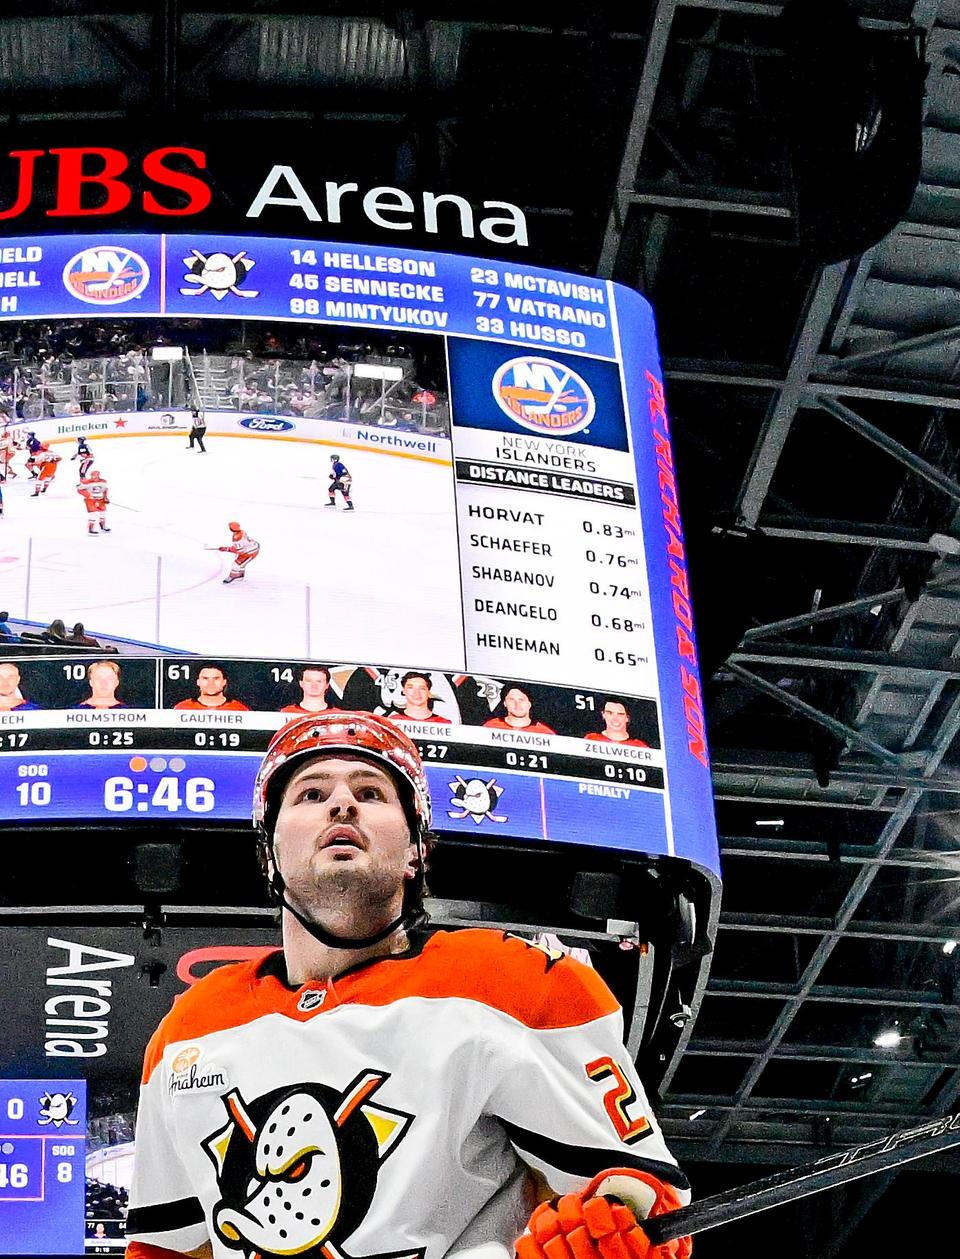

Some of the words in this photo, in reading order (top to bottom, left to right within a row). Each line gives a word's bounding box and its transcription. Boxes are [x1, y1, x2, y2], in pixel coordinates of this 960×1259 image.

[246, 165, 528, 247] Arena
[82, 251, 134, 274] NY
[289, 251, 317, 268] 14
[323, 253, 437, 278] HELLESON
[288, 275, 319, 292] 45
[324, 276, 445, 304] SENNECKE
[470, 270, 499, 286] 23
[504, 273, 605, 305] MCTAVISH
[288, 299, 319, 317] 98
[324, 302, 449, 329] MINTYUKOV
[474, 292, 501, 310] 77
[506, 297, 607, 329] VATRANO
[476, 317, 505, 335] 33
[510, 321, 587, 349] HUSSO
[512, 361, 574, 391] NY
[58, 421, 108, 435] Heineken
[248, 417, 285, 431] Ford
[357, 430, 436, 453] Northwell
[503, 435, 540, 451] NEW
[544, 443, 587, 459] YORK
[496, 447, 597, 473] ISLANDERS
[468, 464, 549, 490] DISTANCE
[551, 477, 626, 502] LEADERS
[467, 504, 546, 526] HORVAT
[469, 533, 553, 559] SCHAEFER
[471, 564, 555, 589] SHABANOV
[474, 598, 558, 622] DEANGELO
[476, 632, 561, 658] HEINEMAN
[63, 664, 86, 681] 10
[167, 664, 191, 681] 61
[271, 667, 294, 683] 14
[476, 681, 501, 699] 23
[574, 694, 596, 711] 51
[66, 711, 148, 725] HOLMSTROM
[180, 713, 245, 726] GAUTHIER
[681, 664, 708, 768] SON
[89, 729, 135, 748] 0:25
[194, 731, 240, 748] 0:19
[405, 725, 453, 738] NNECKE
[491, 733, 551, 749] MCTAVISH
[418, 743, 449, 760] :27
[505, 751, 549, 770] 0:21
[585, 743, 653, 762] ZELLWEGER
[18, 763, 49, 778] SOG
[605, 764, 647, 783] 0:10
[16, 783, 51, 808] 10
[103, 776, 216, 814] 6:46
[578, 782, 630, 800] PENALTY
[43, 937, 135, 1061] Arena
[6, 1098, 24, 1121] 0
[56, 1162, 73, 1183] 8
